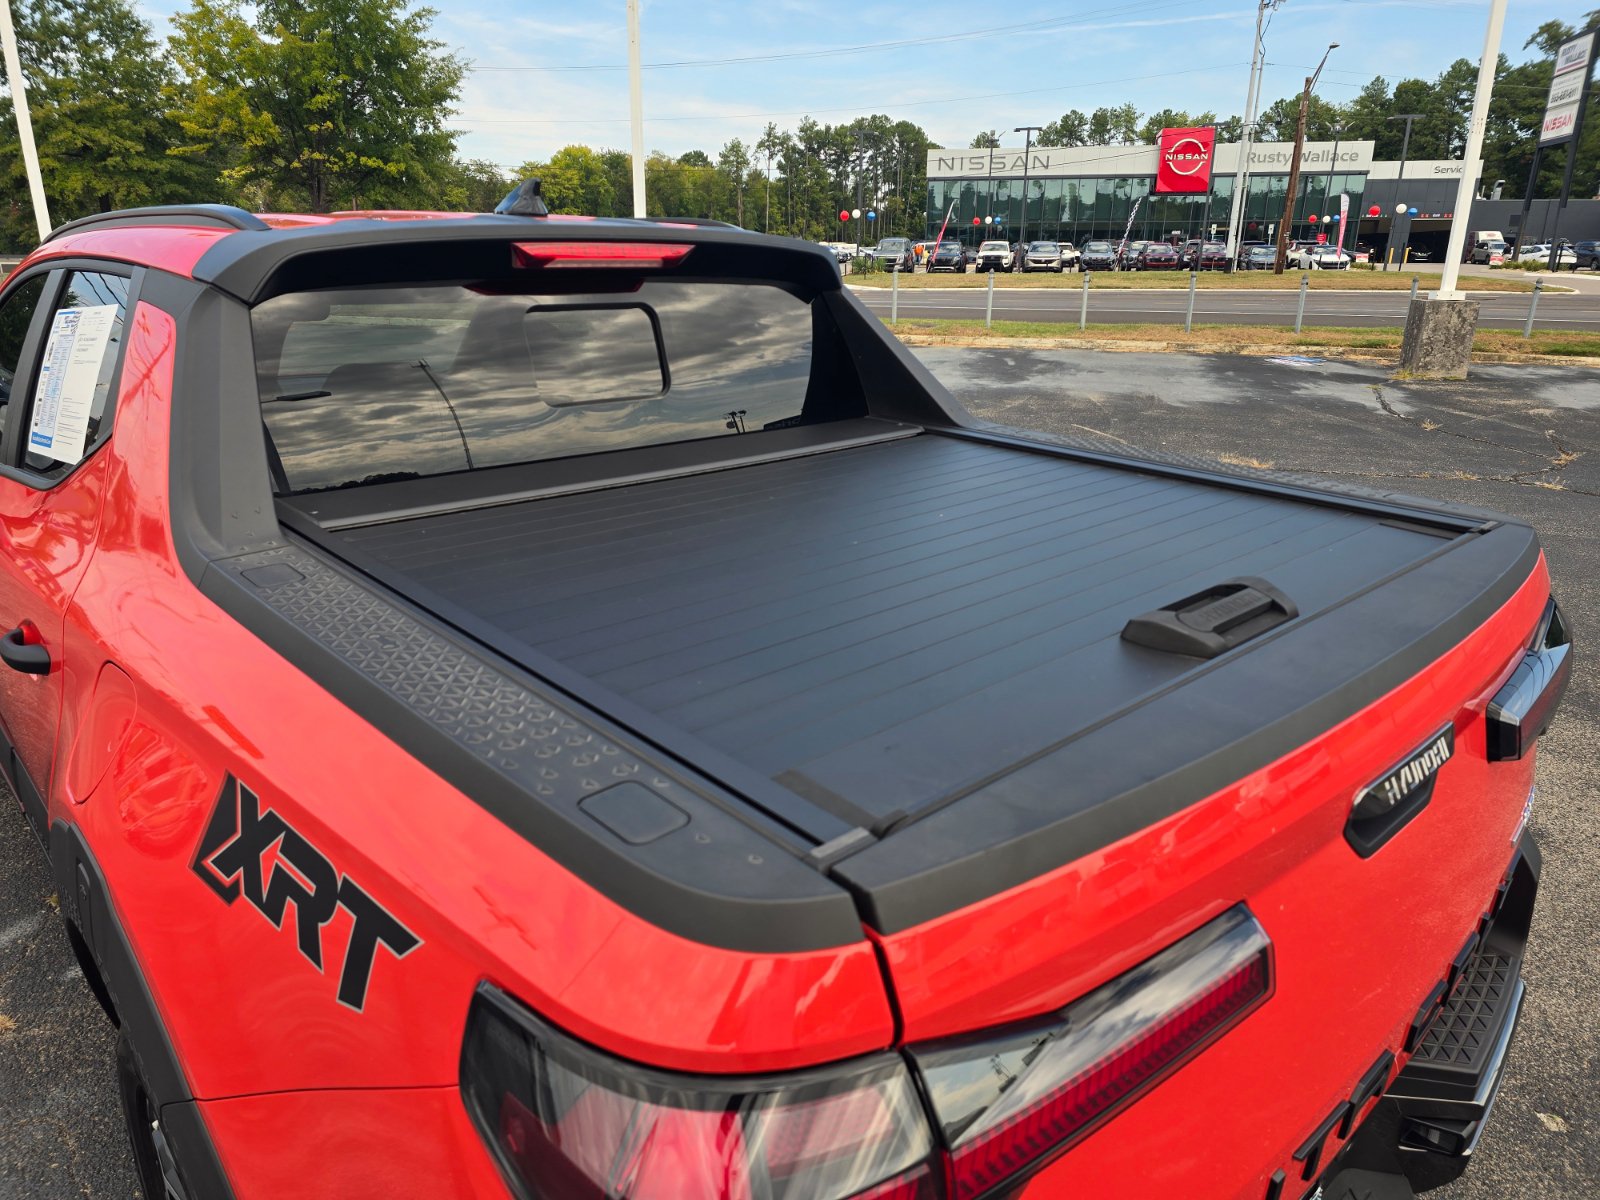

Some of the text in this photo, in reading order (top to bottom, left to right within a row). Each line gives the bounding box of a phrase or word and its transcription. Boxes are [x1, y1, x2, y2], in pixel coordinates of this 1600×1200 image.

[1543, 113, 1574, 132] NISSAN
[938, 155, 1050, 171] NISSAN
[1165, 153, 1208, 161] NISSAN
[1246, 150, 1360, 166] Rusty Wallace
[1434, 165, 1463, 174] Servic
[207, 777, 426, 1014] XRT
